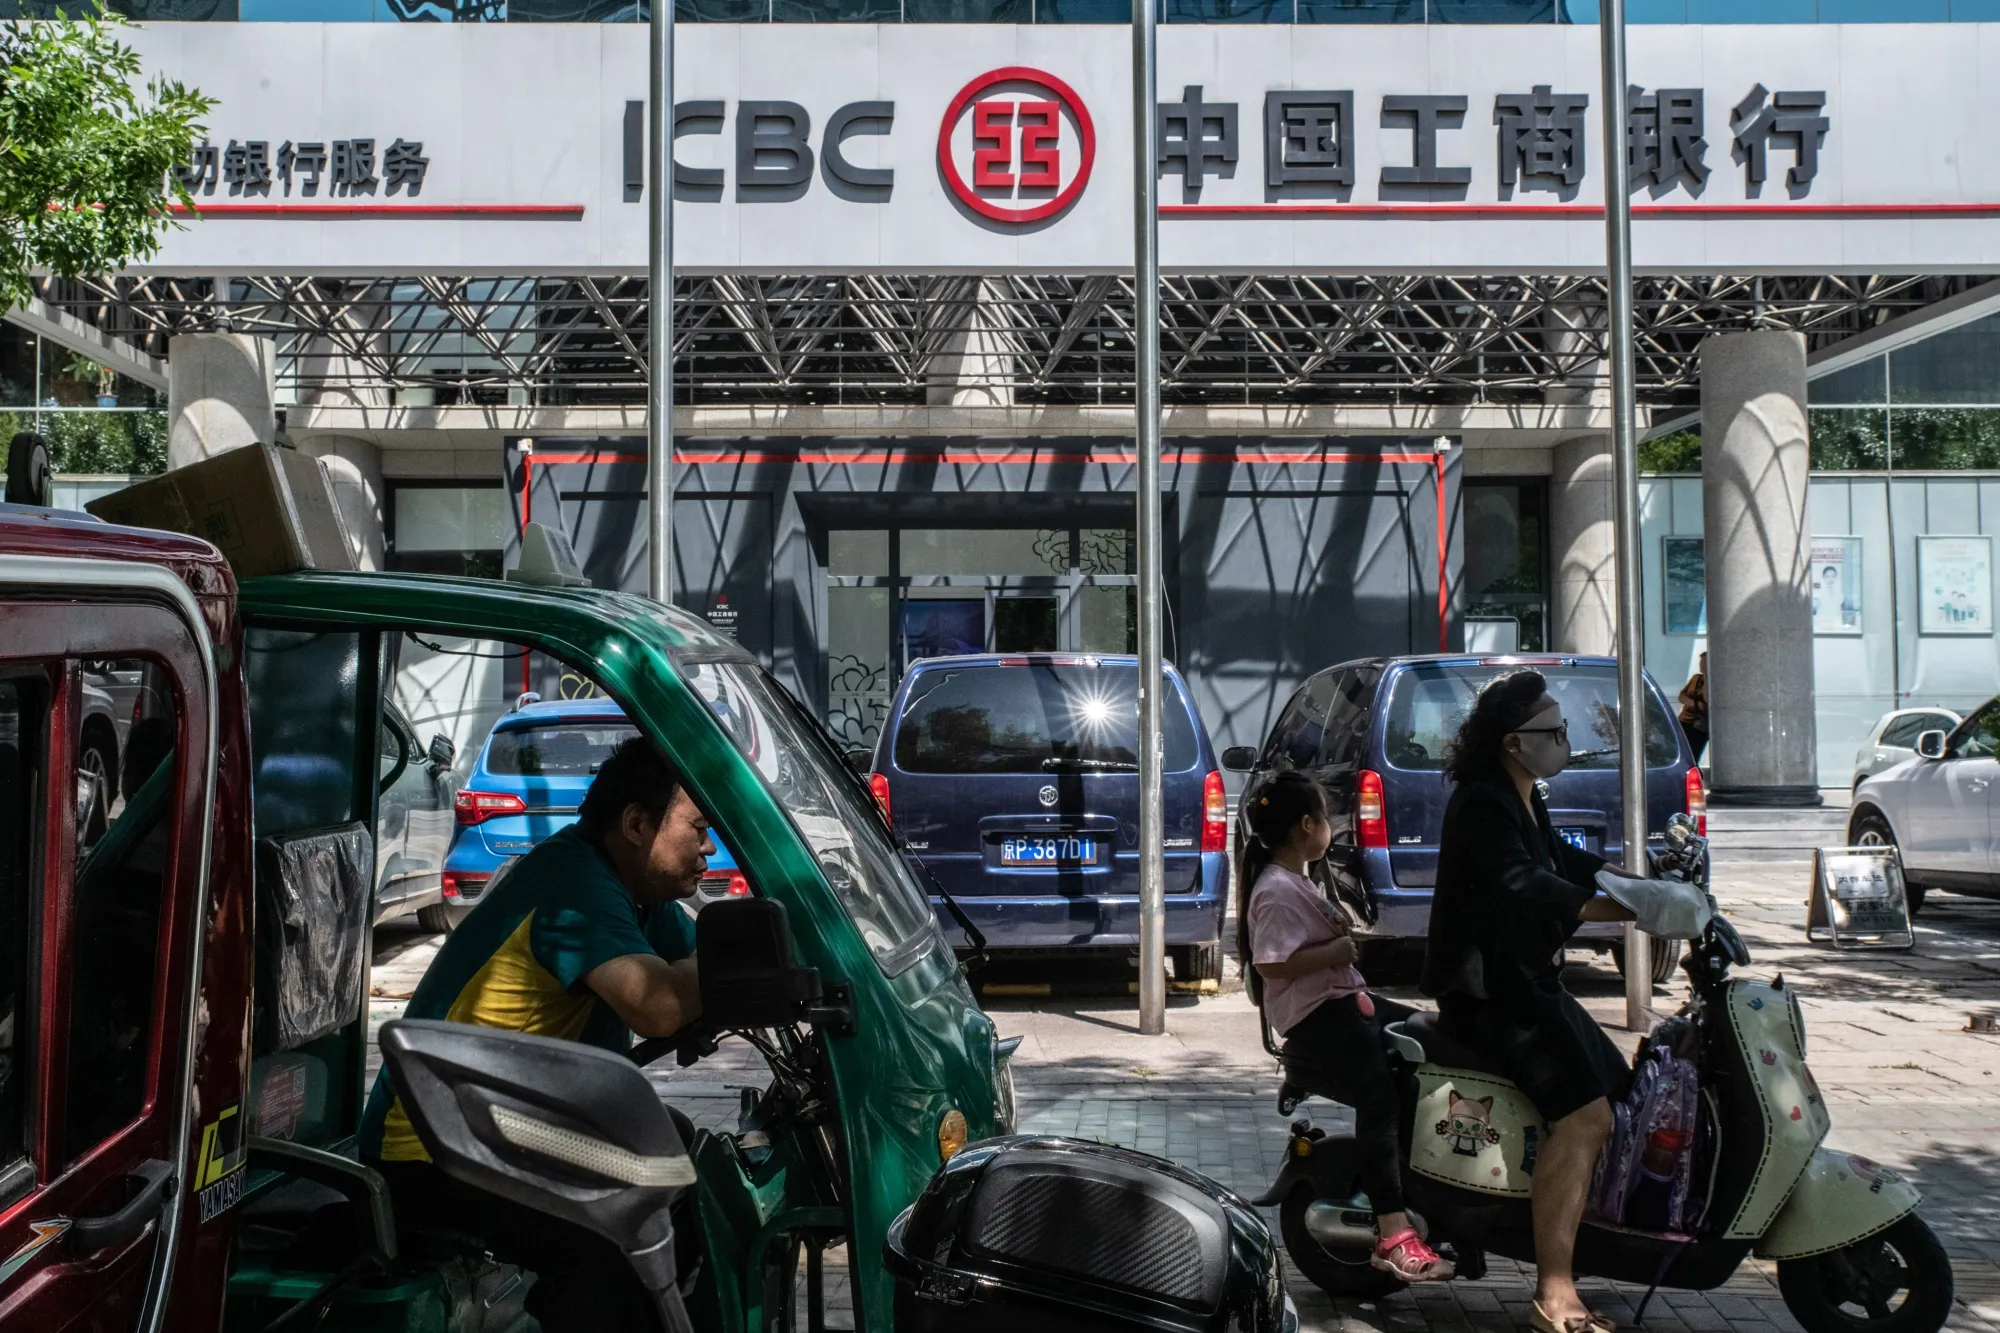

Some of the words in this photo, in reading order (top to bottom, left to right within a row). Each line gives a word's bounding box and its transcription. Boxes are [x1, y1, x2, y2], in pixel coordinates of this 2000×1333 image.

[624, 100, 895, 190] ICBC
[1158, 83, 1830, 190] 中国工商银行
